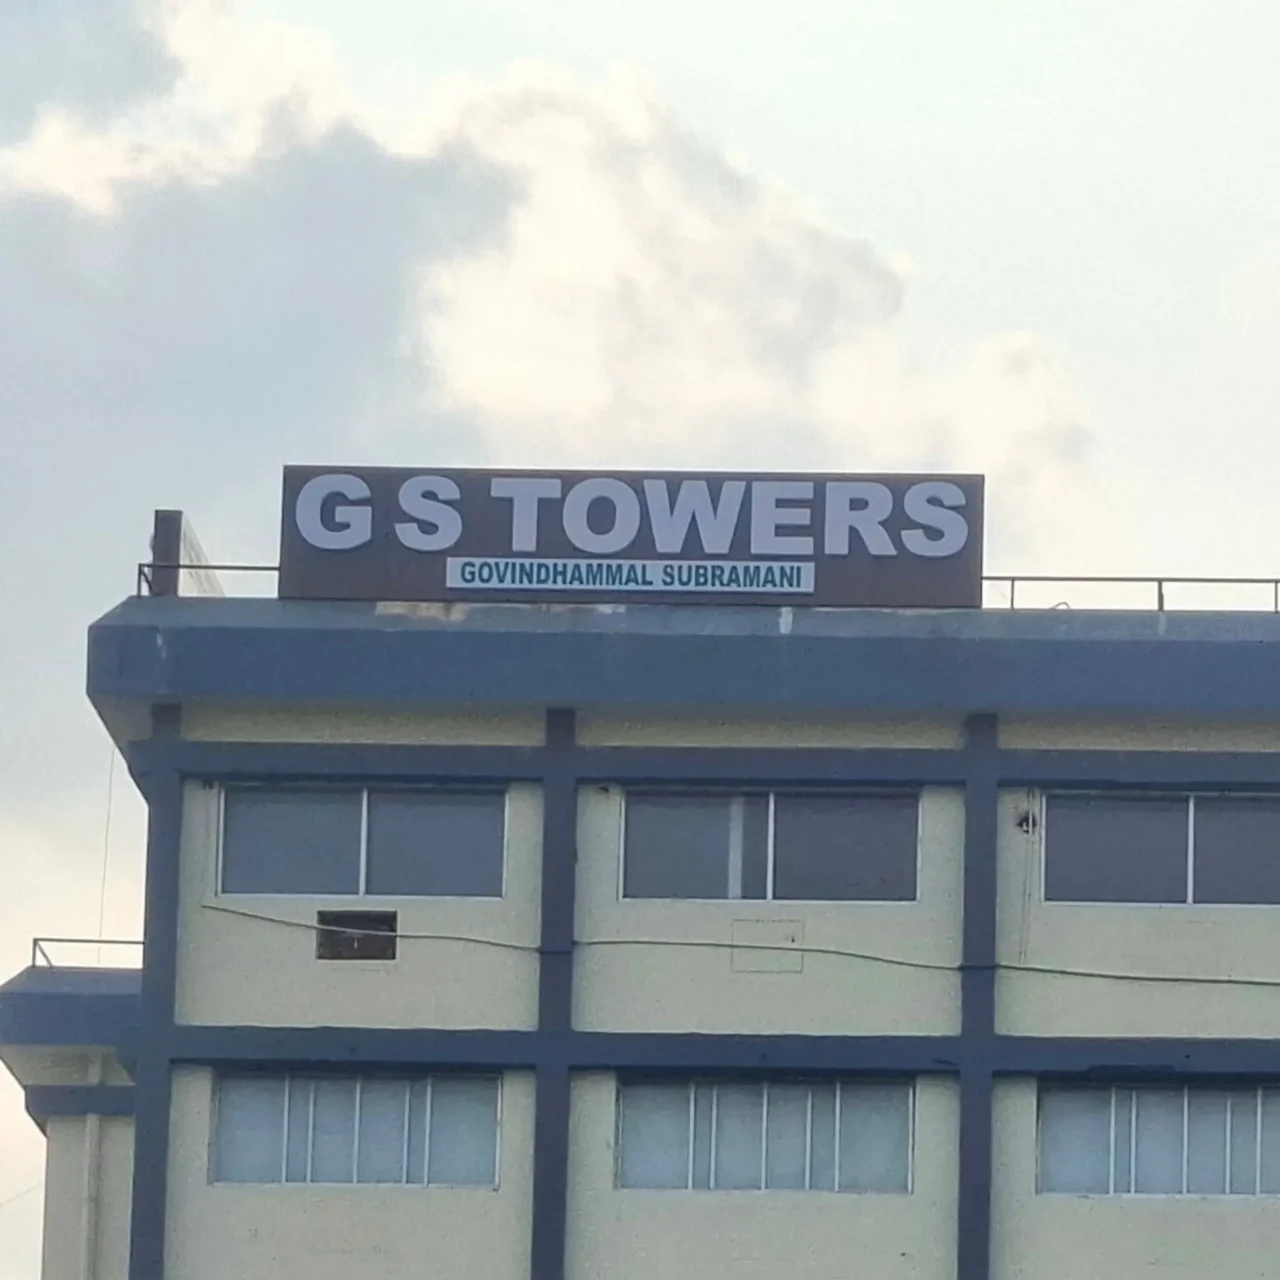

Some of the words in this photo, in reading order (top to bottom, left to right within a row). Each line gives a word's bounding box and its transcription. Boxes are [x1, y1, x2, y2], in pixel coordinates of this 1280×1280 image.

[295, 474, 372, 551] G
[395, 475, 463, 552] S
[492, 478, 969, 557] TOWERS
[461, 562, 654, 588] GOVINDHAMMAL
[662, 565, 803, 589] SUBRAMANI
